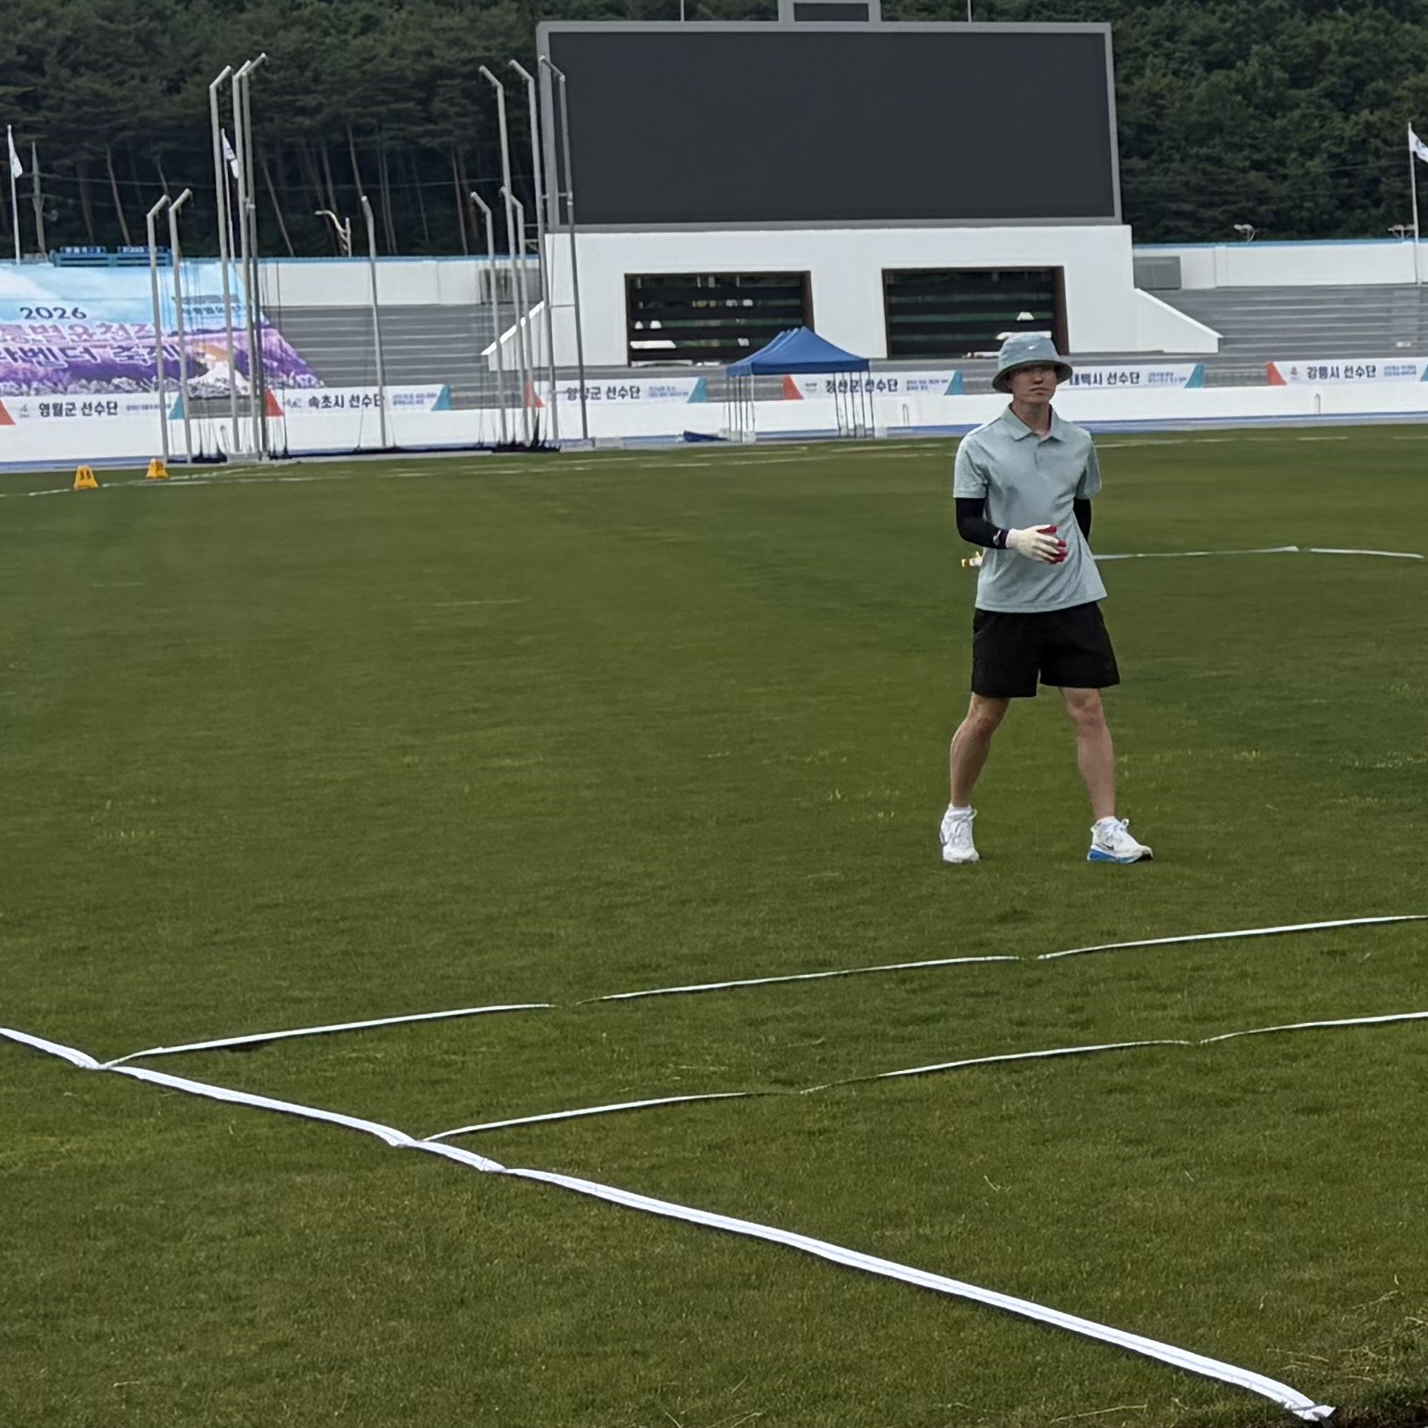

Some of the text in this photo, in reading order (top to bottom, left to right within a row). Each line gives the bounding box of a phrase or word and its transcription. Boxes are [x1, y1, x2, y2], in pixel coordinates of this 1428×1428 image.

[20, 306, 87, 320] 2026
[1107, 372, 1140, 385] 선수단
[1307, 367, 1340, 380] 강릉시
[1344, 365, 1376, 379] 선수단
[606, 385, 640, 400] 선수단
[864, 379, 898, 392] 선수단
[39, 402, 76, 417] 영월군
[81, 401, 118, 416] 선수단
[308, 396, 344, 409] 속초시
